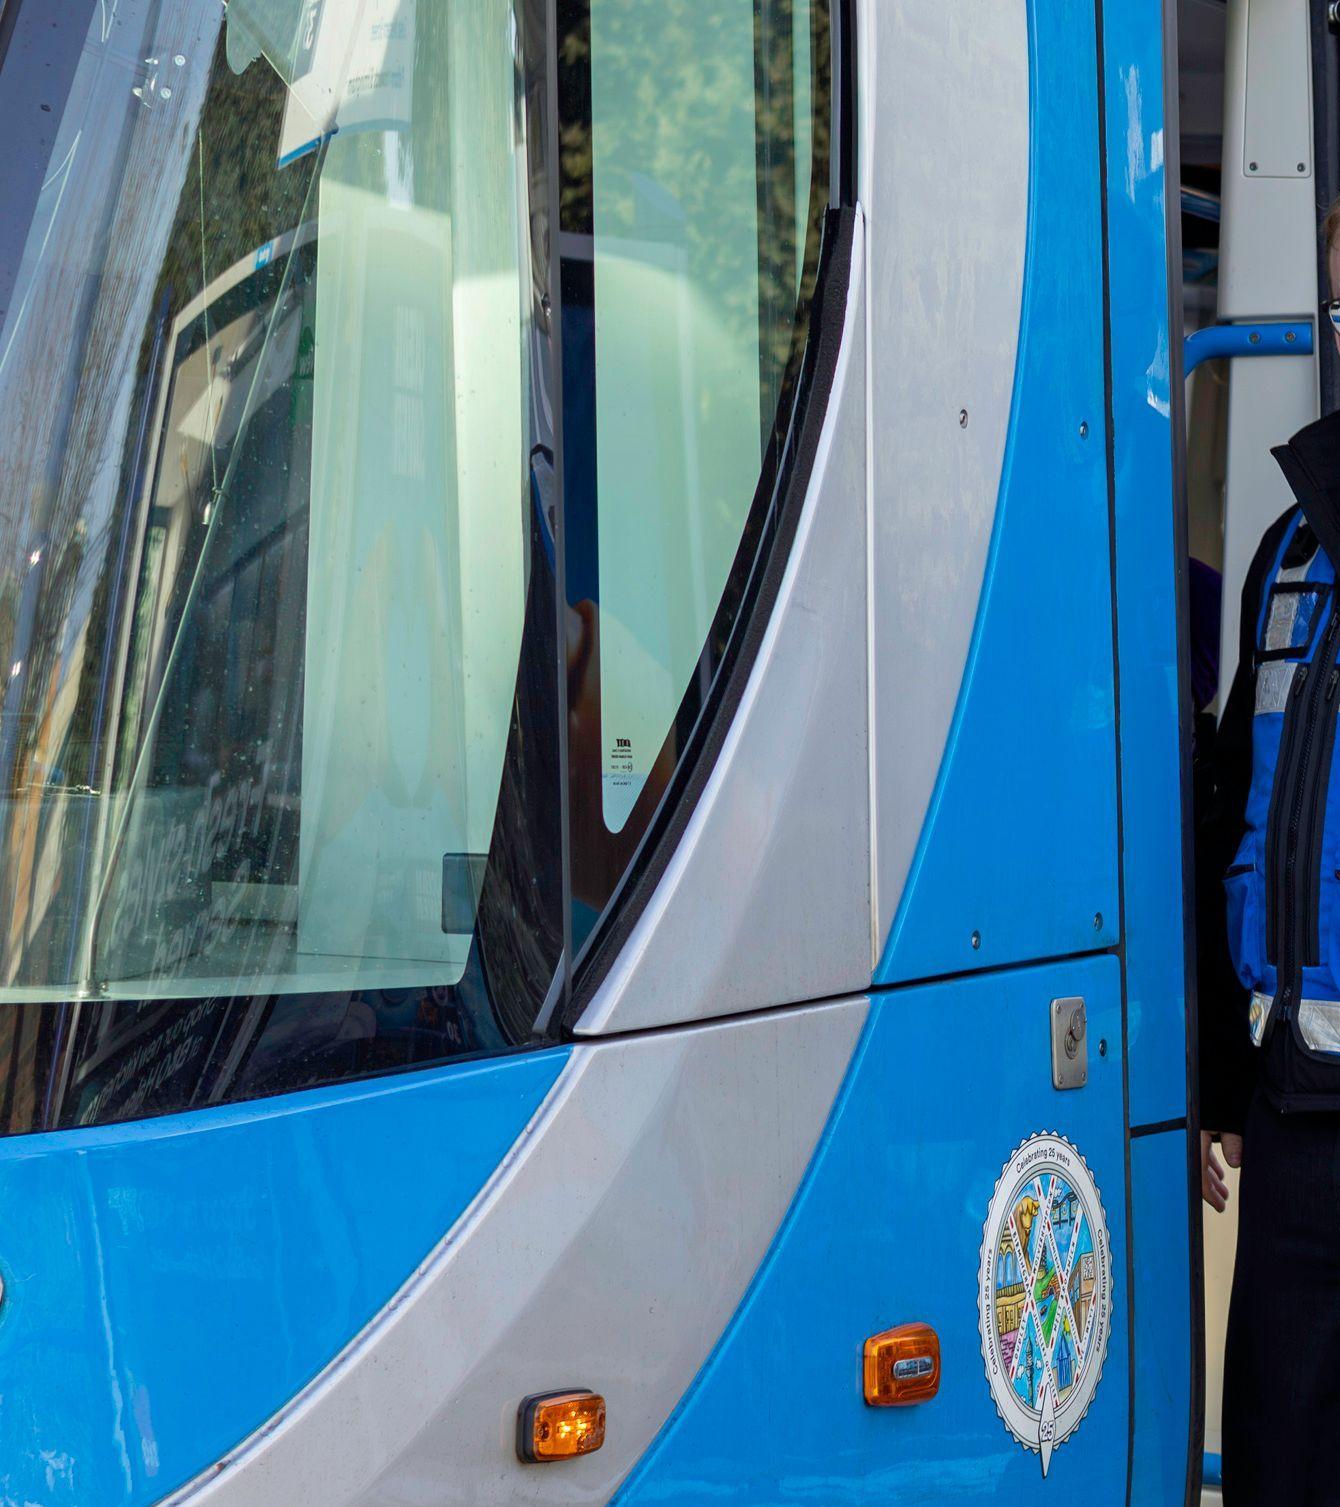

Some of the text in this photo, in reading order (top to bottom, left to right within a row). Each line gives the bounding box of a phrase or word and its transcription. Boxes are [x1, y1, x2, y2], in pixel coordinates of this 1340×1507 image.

[1016, 1147, 1070, 1174] Celebrating 25 years
[1012, 1231, 1032, 1299] BIRMINGHAM
[1095, 1228, 1107, 1353] Celebrating 25 years
[983, 1248, 998, 1375] Celebrating 25 years
[1041, 1421, 1055, 1443] 25
